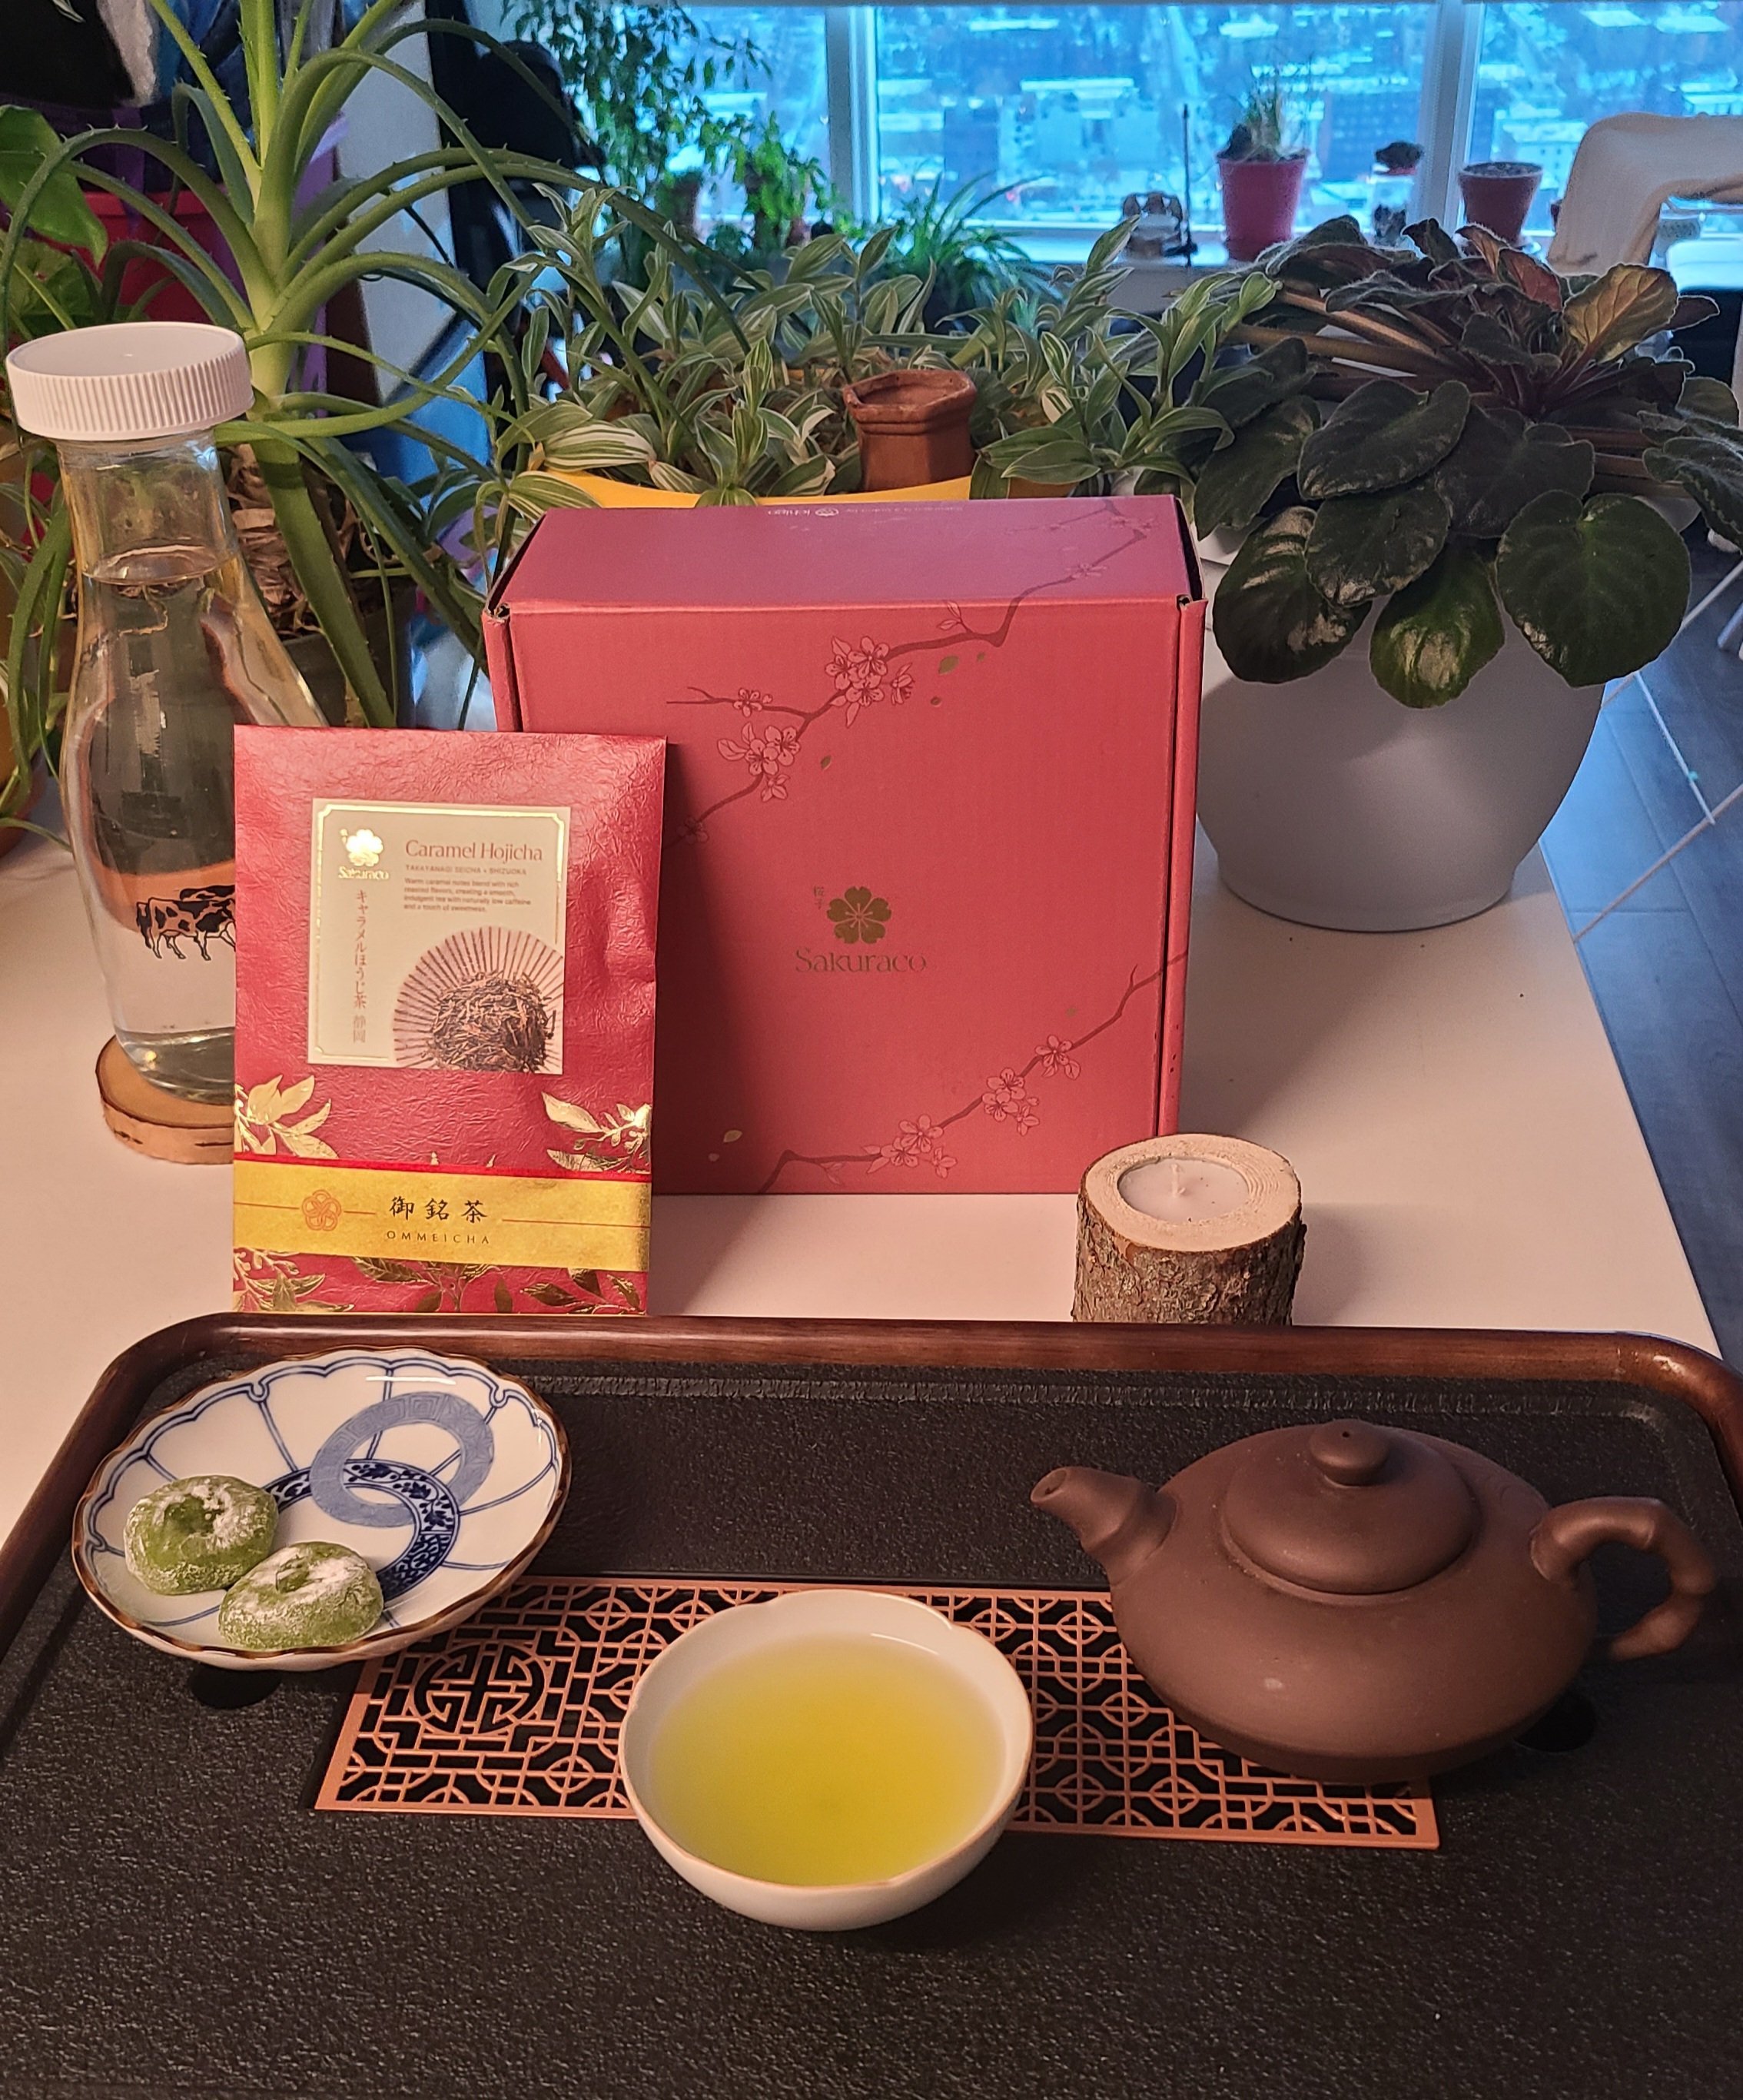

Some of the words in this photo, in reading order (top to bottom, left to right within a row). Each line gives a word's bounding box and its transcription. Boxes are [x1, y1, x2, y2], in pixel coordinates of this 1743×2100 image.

[405, 839, 476, 859] Caramel
[480, 842, 543, 864] Hojicha
[405, 865, 453, 873] TAKAYANAGI
[489, 867, 526, 876] SHIZUOKA
[795, 946, 927, 972] Sakuraco
[388, 1195, 488, 1224] 御銘茶
[386, 1230, 490, 1244] OMMEICHA
